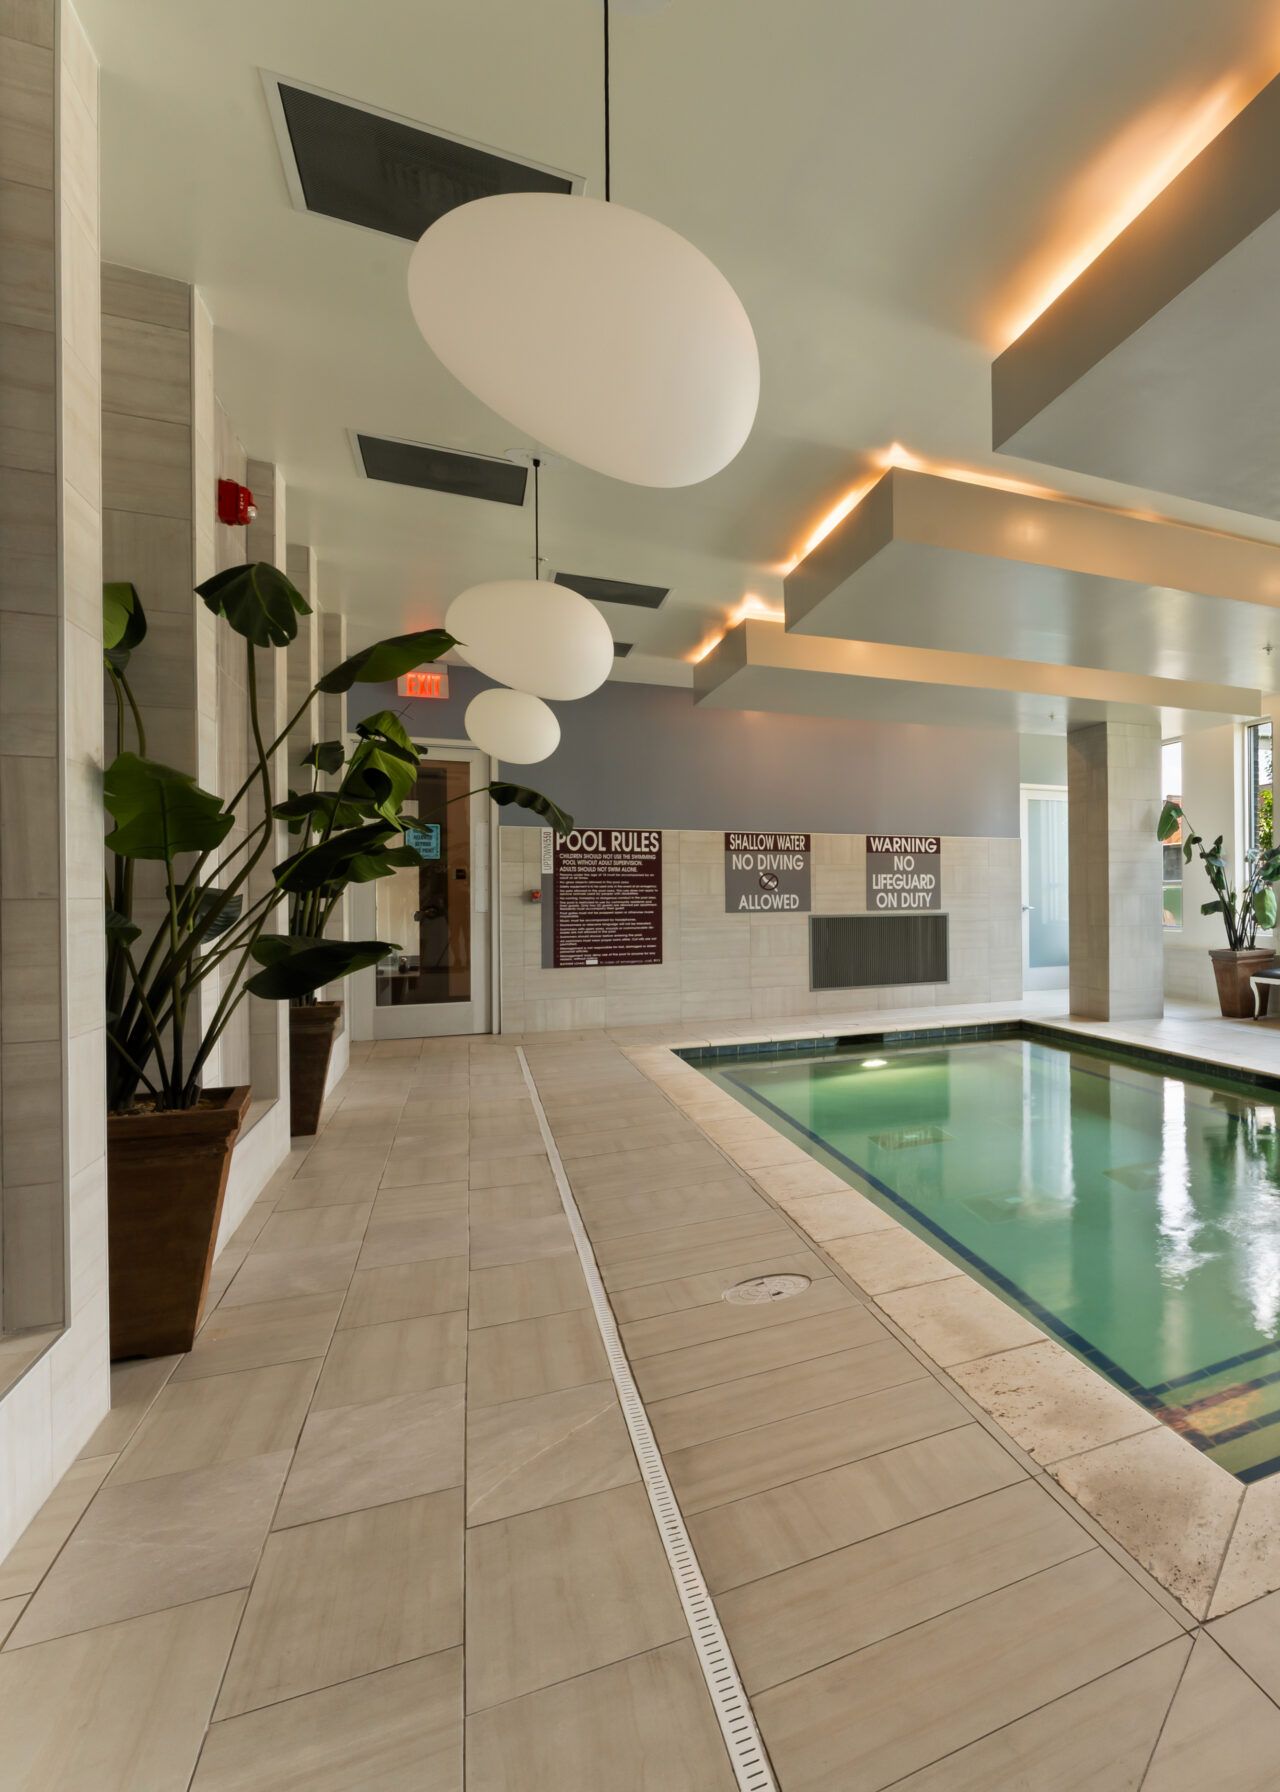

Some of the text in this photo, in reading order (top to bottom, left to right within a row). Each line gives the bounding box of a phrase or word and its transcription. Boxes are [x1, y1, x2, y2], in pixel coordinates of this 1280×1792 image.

[406, 672, 441, 697] EXIT
[556, 831, 660, 853] POOL RULES
[729, 834, 805, 851] SHALLOW WATER
[870, 837, 937, 853] WARNING
[732, 854, 804, 871] NO DIVING
[894, 856, 915, 871] NO
[872, 874, 935, 890] LIFEGUARD
[738, 894, 799, 910] ALLOWED
[876, 892, 932, 908] ON DUTY
